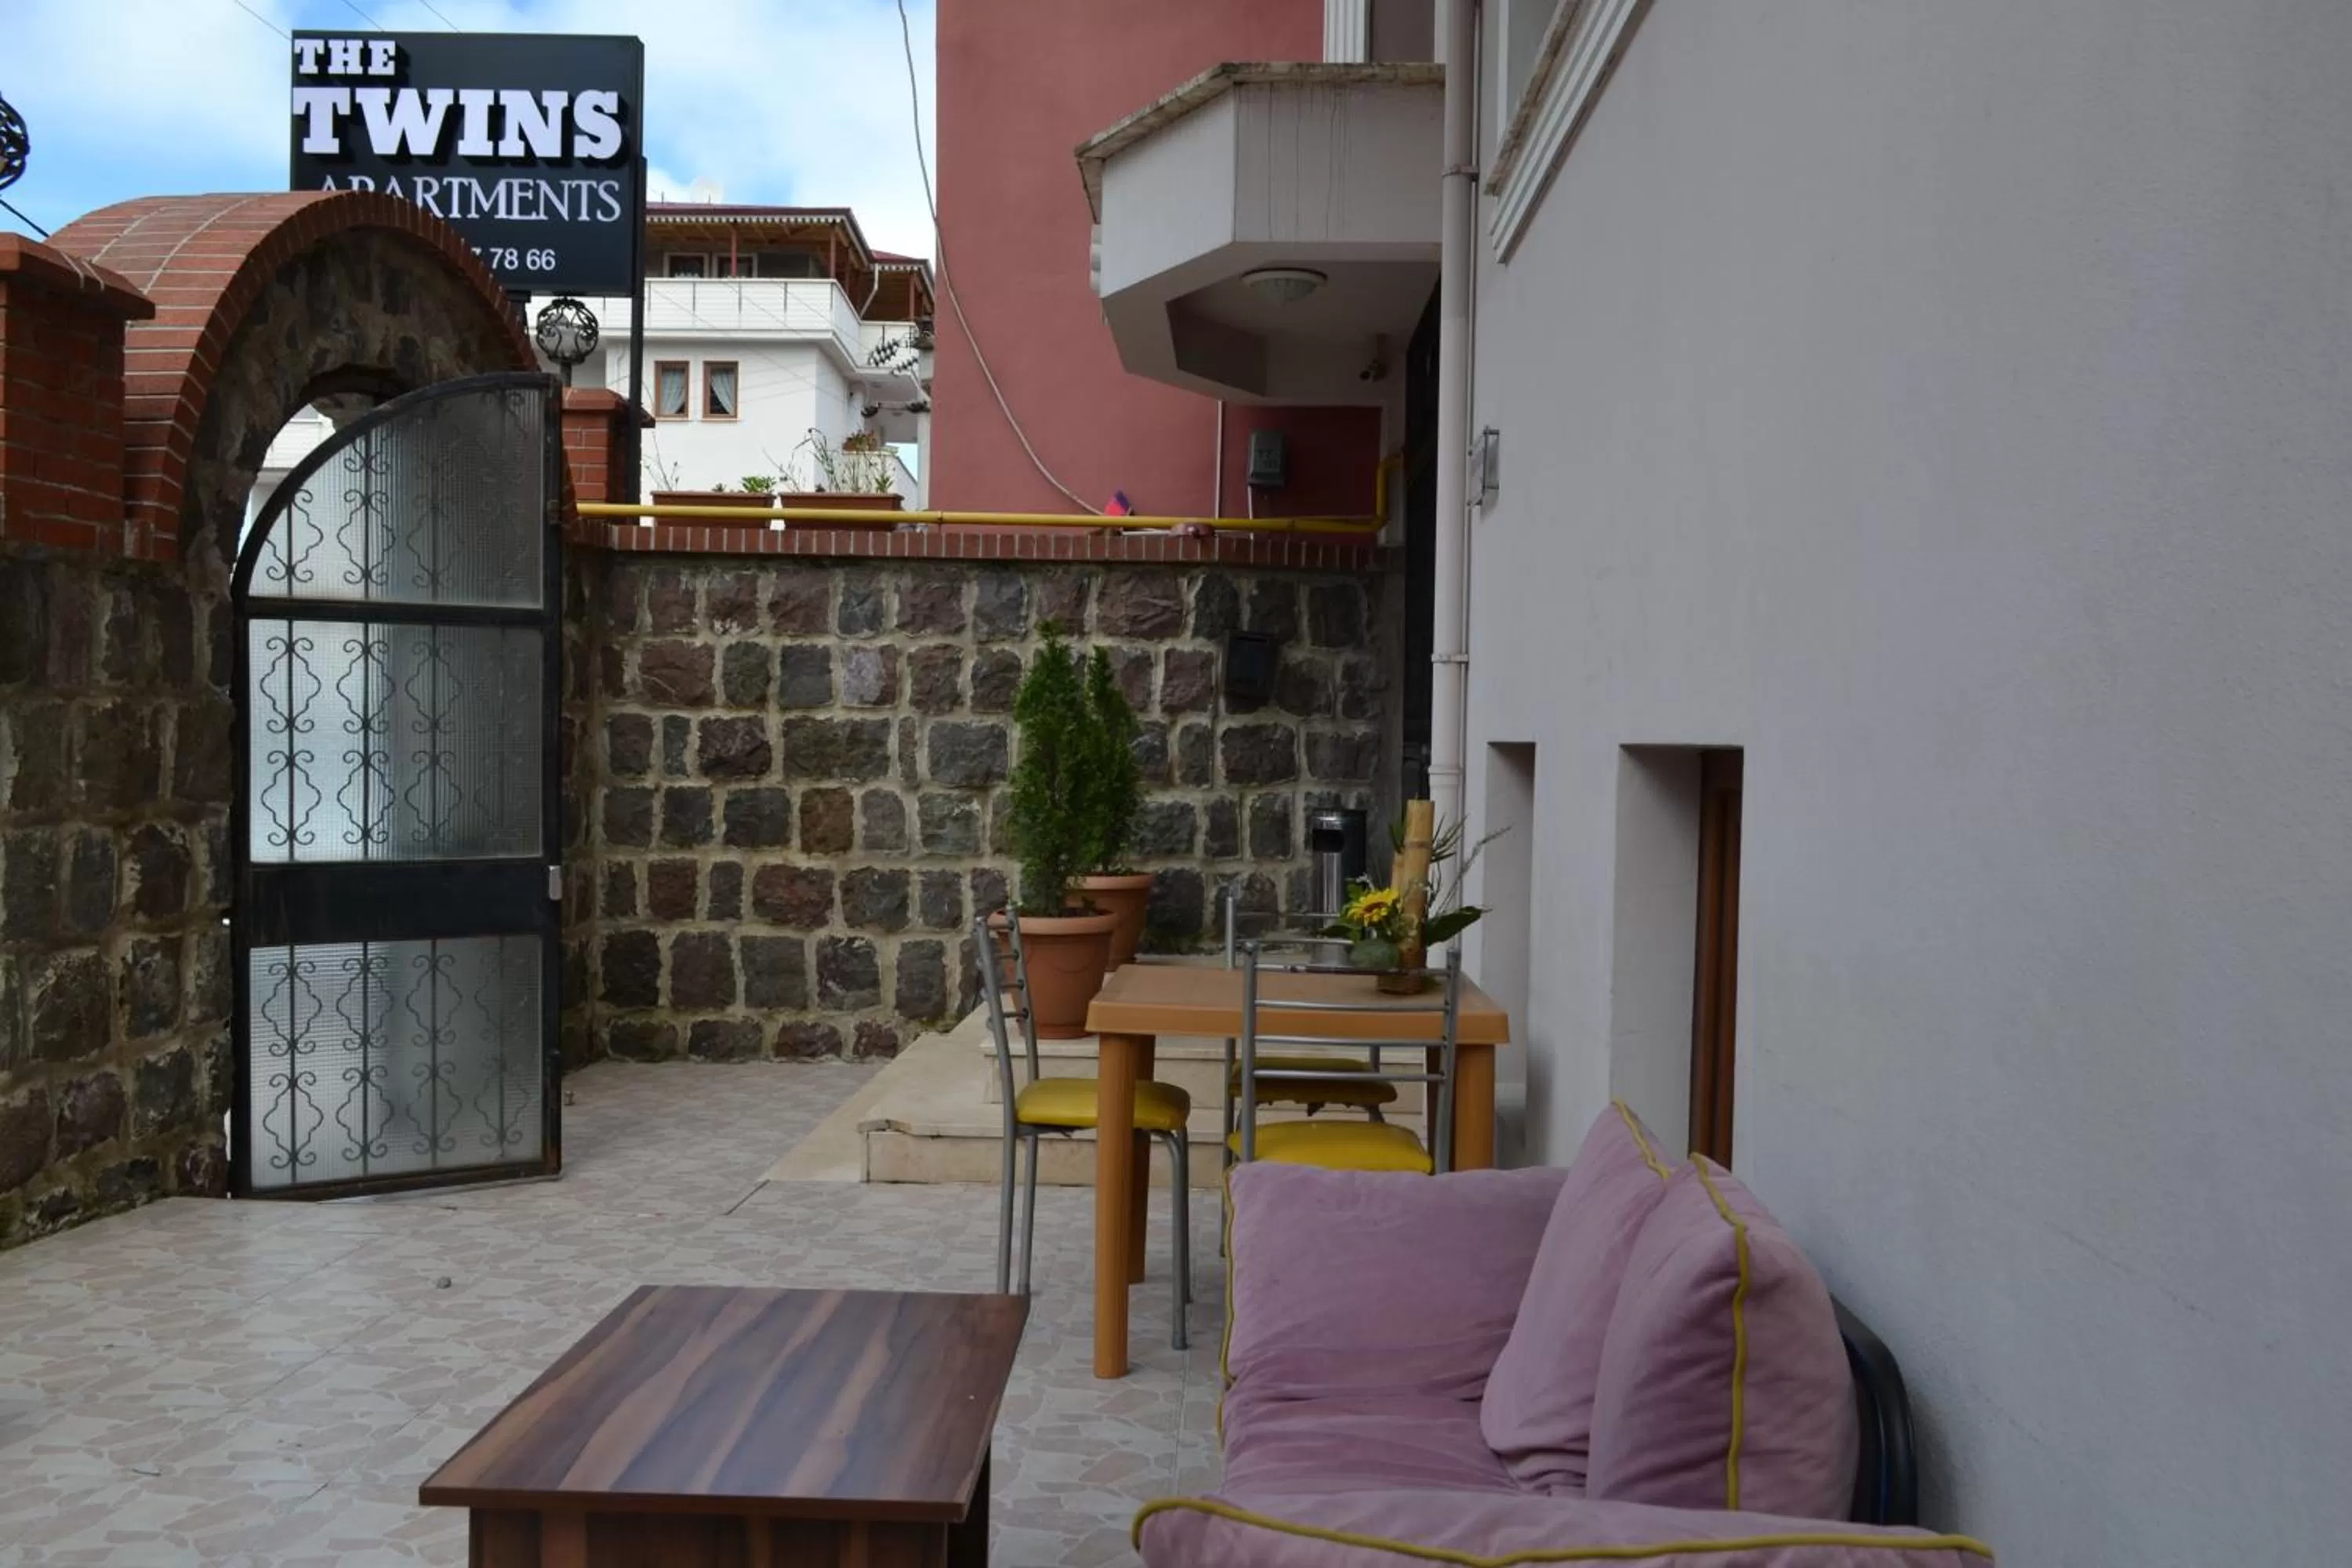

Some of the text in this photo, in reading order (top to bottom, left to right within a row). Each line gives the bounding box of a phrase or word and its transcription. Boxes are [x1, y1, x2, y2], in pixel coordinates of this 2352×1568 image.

[294, 38, 396, 76] THE
[292, 87, 622, 160] TWINS
[489, 247, 557, 271] 78 66
